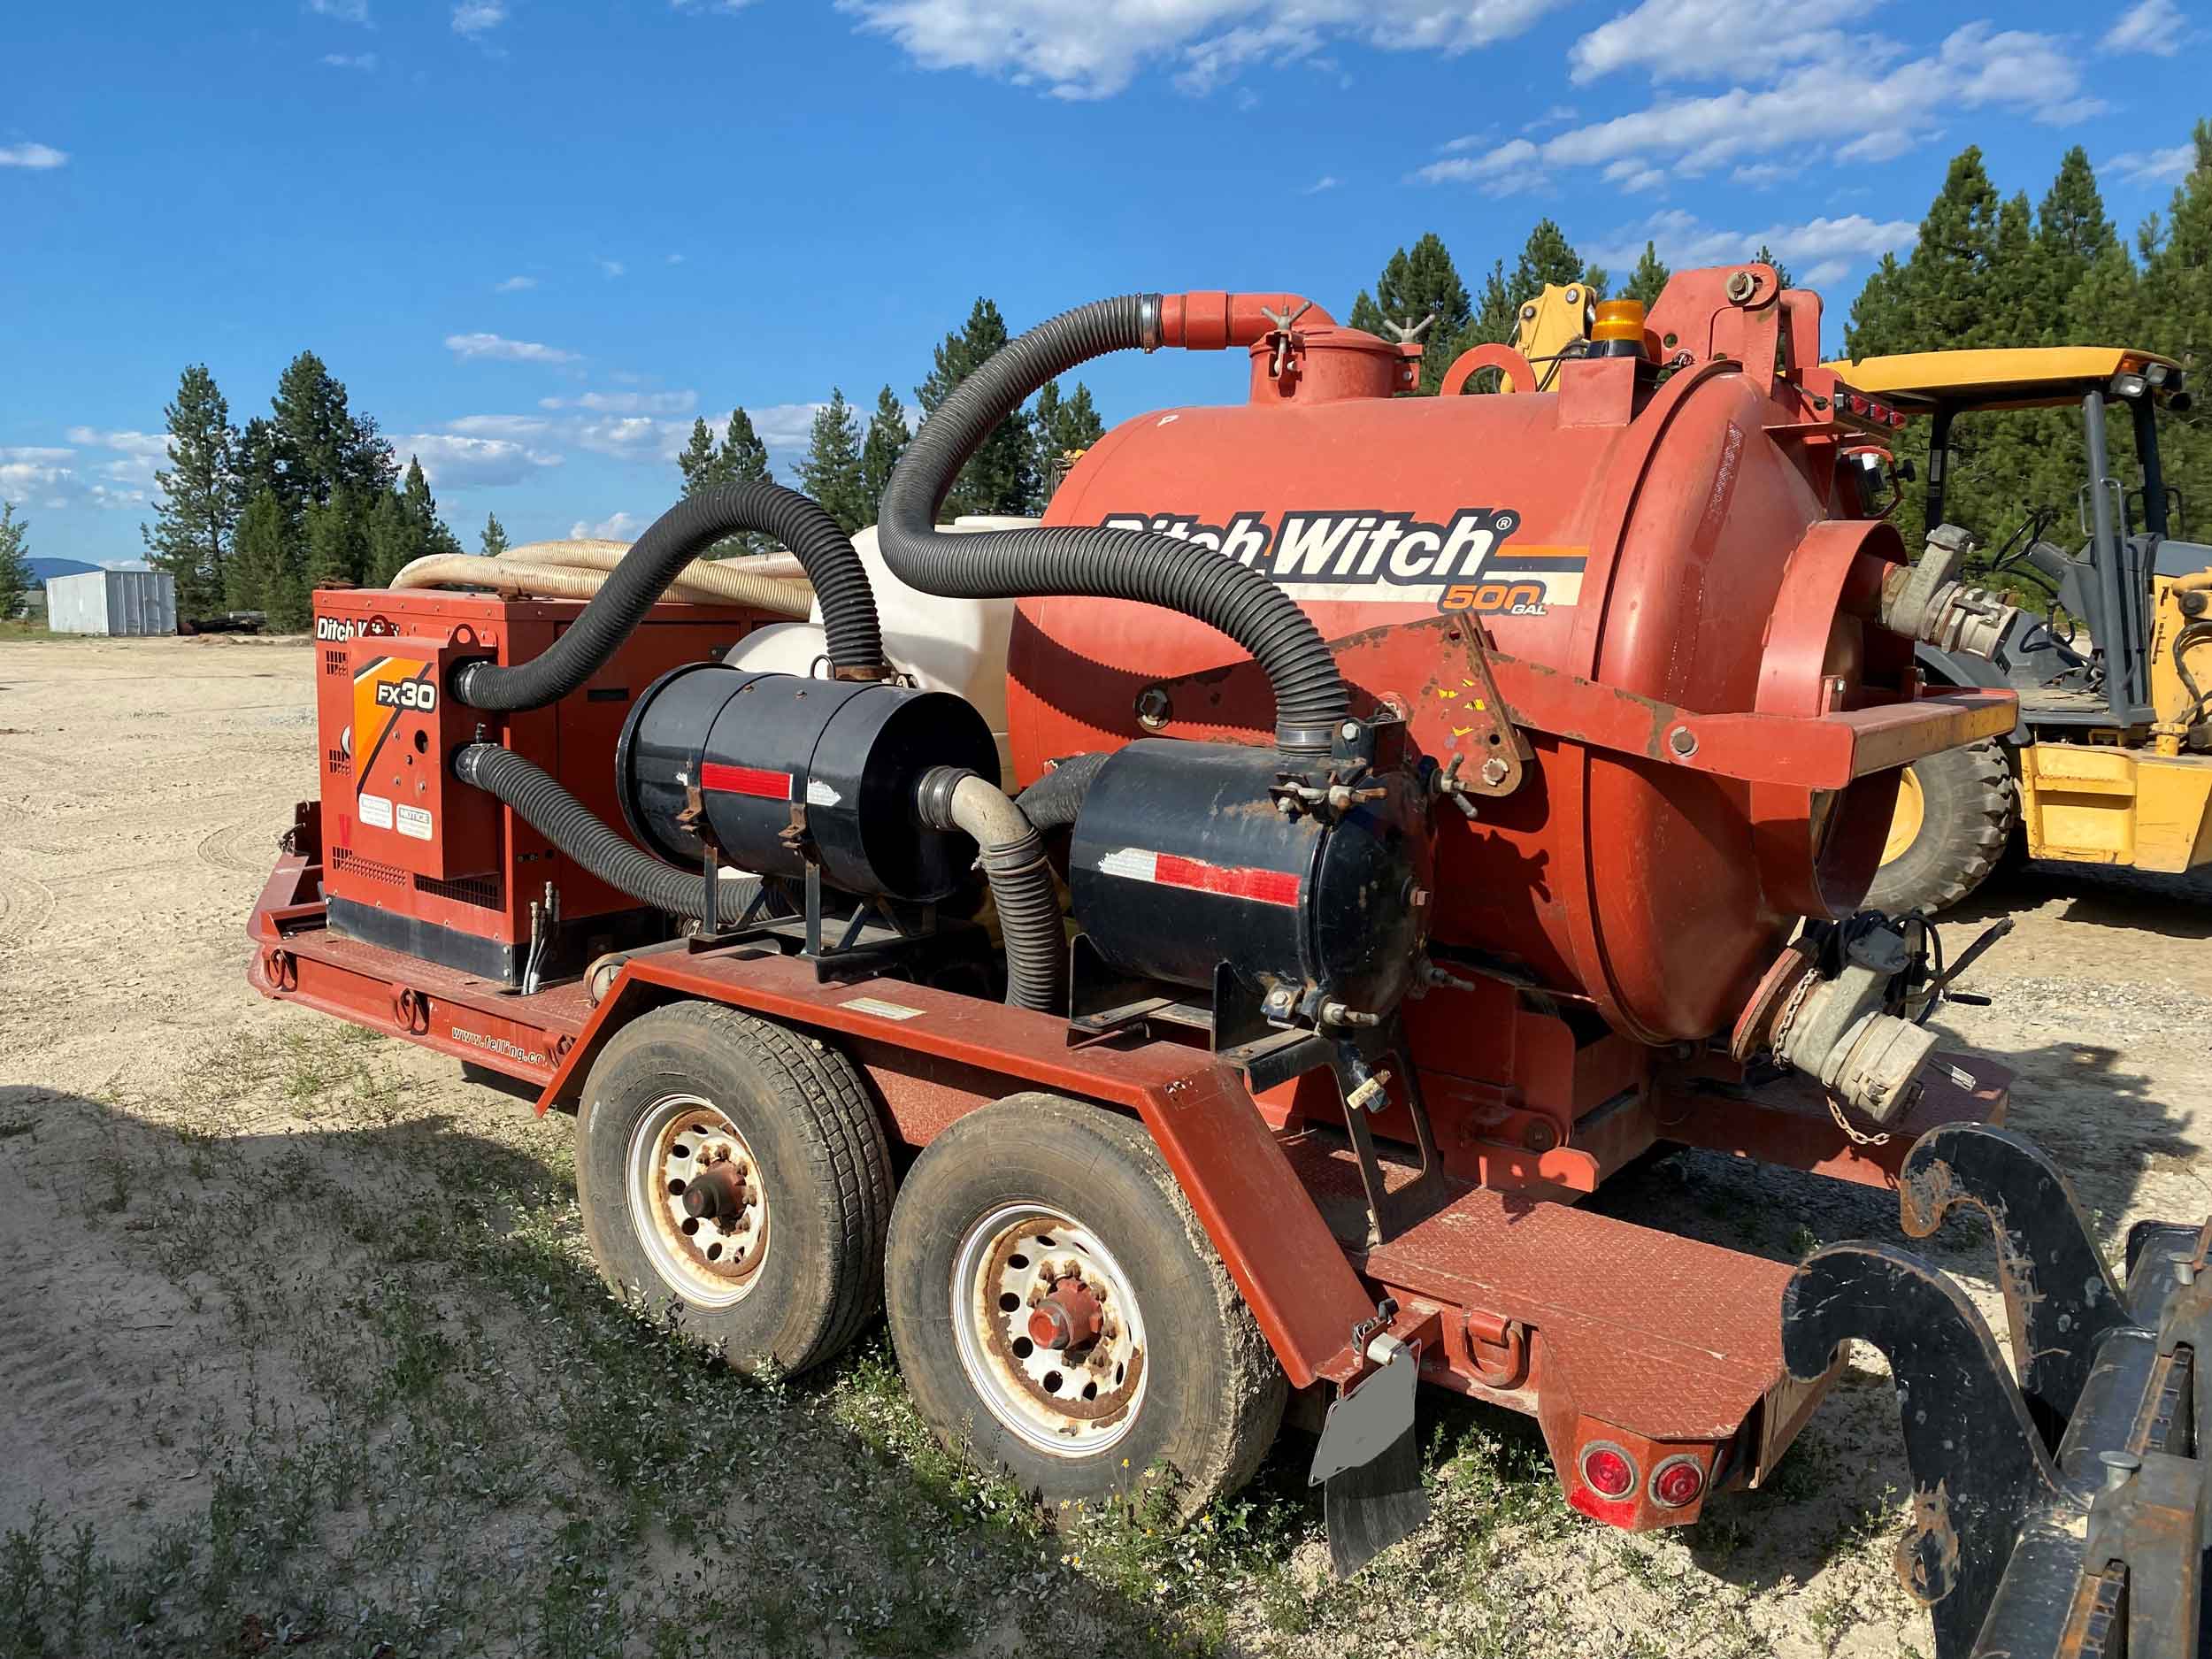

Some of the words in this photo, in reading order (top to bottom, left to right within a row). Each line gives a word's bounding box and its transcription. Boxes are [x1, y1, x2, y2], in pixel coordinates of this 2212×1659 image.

[1443, 585, 1541, 611] 500
[1510, 603, 1548, 615] GAL
[317, 617, 356, 641] Ditch
[378, 681, 435, 710] FX30
